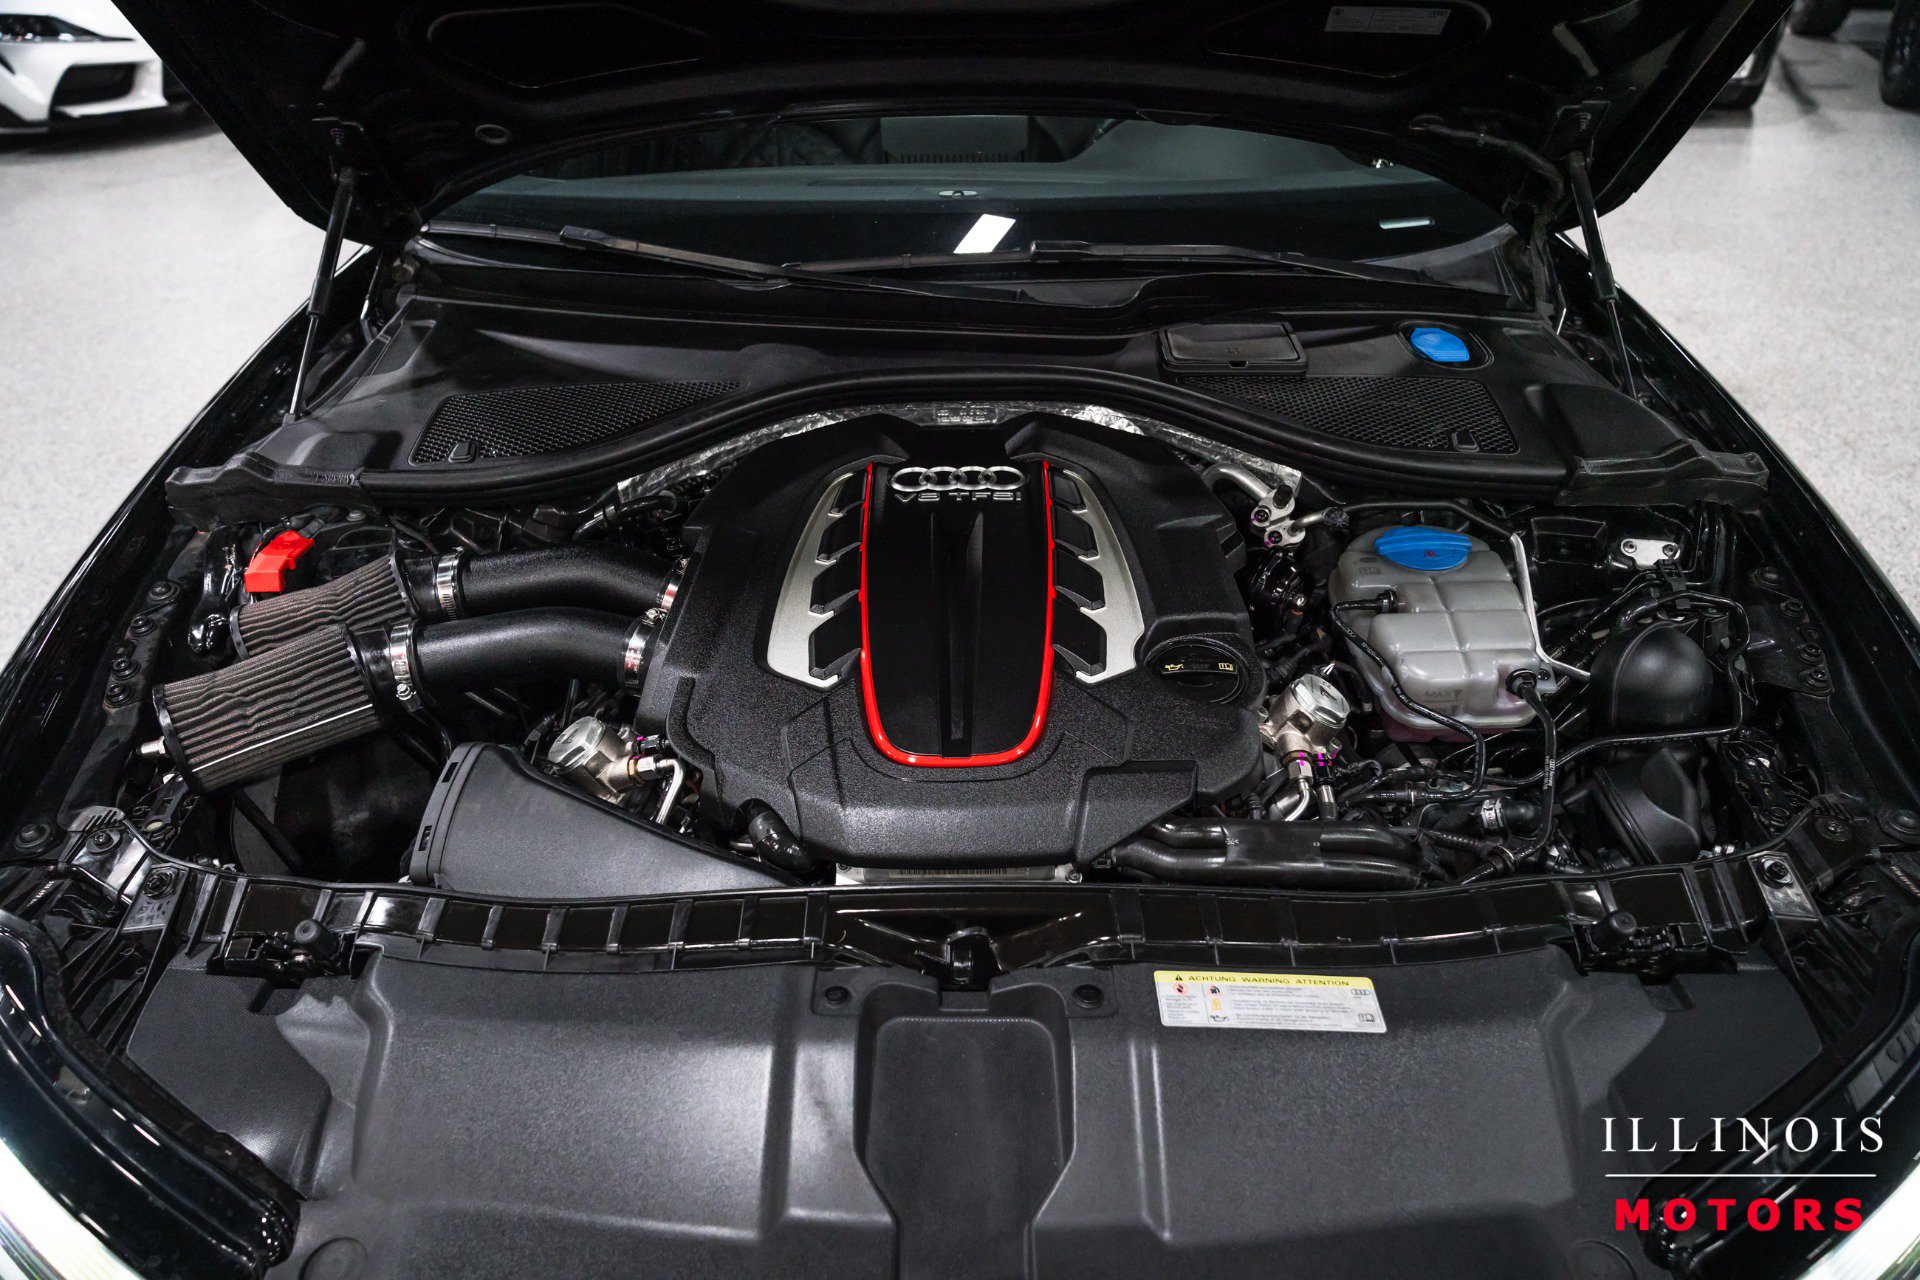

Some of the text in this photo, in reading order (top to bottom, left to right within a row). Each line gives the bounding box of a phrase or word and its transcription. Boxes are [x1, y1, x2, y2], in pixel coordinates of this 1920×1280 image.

[949, 491, 1022, 502] TFSI
[1188, 975, 1350, 987] ACHTUNG WARNING ATTENTION
